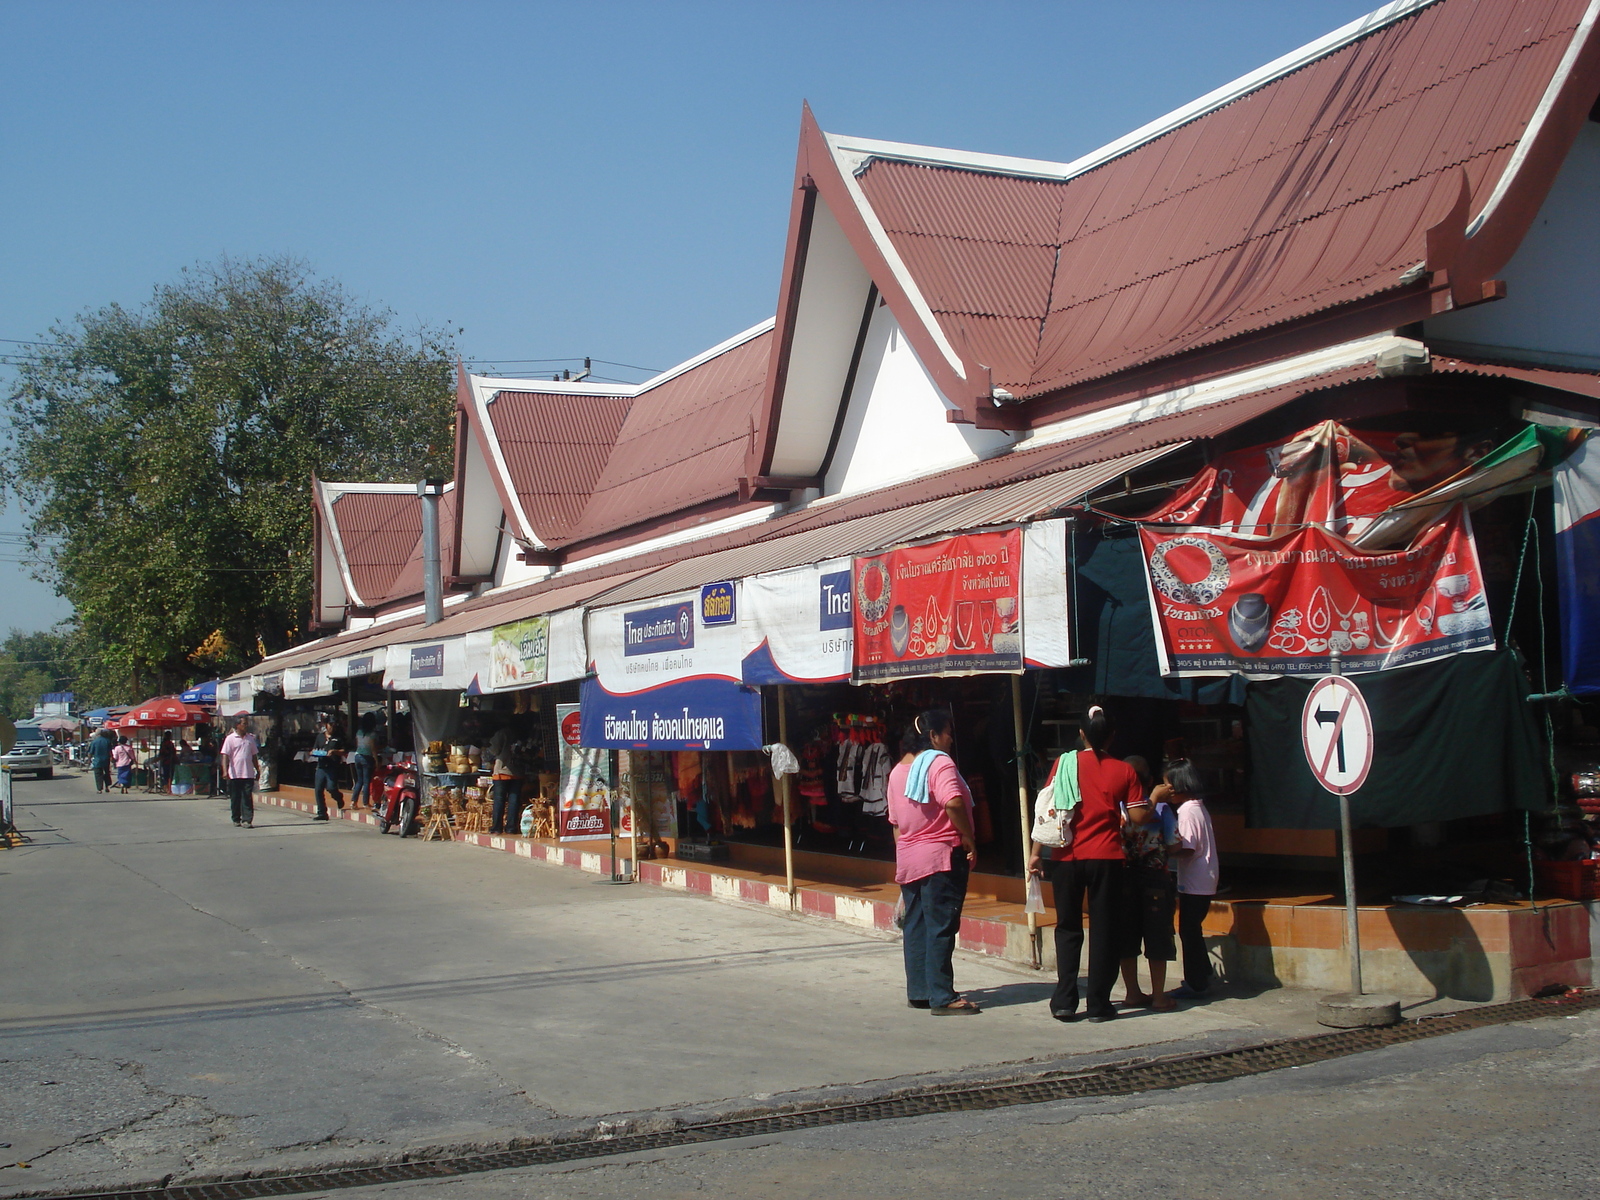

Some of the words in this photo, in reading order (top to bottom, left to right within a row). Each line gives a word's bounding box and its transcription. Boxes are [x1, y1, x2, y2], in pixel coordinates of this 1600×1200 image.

[604, 709, 648, 741] ชีวิตคนไทย
[652, 707, 724, 749] ต้องคนไทยดูแล
